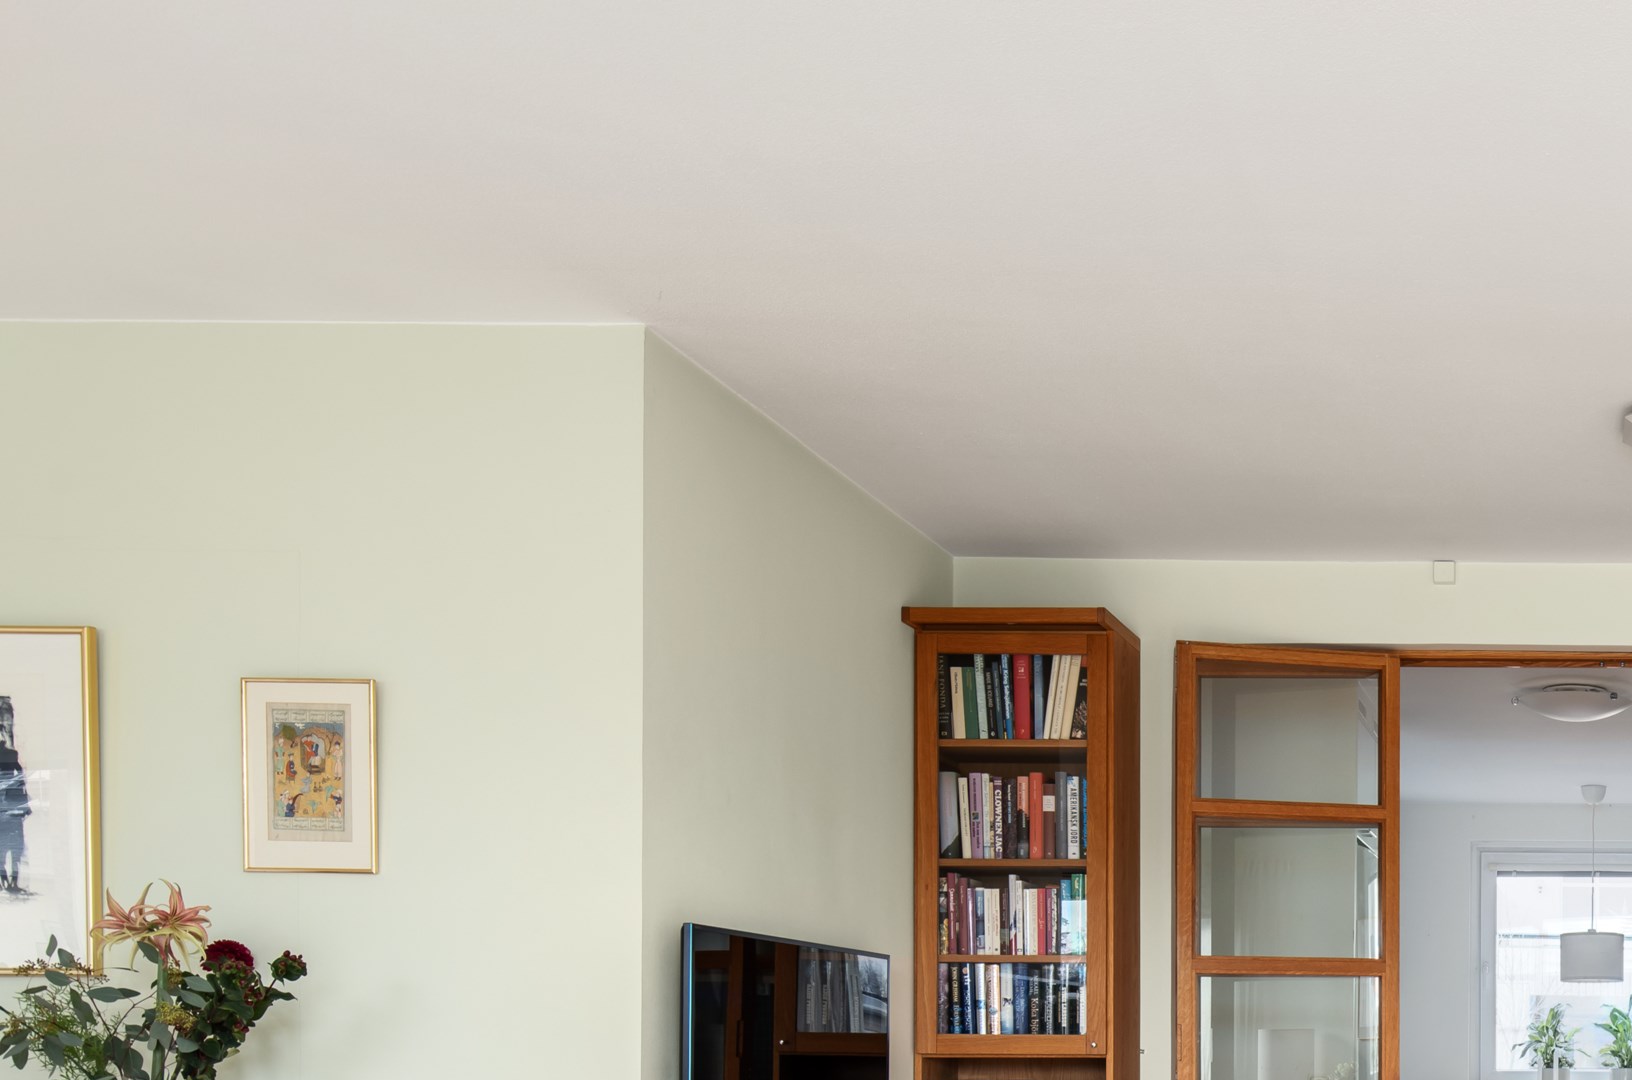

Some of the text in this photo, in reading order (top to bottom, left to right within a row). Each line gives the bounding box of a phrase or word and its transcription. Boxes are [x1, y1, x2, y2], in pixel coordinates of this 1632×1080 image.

[994, 789, 1002, 834] CLOWNEN
[1070, 787, 1078, 844] AMERIKANSK JORD
[1030, 997, 1039, 1018] Koka
